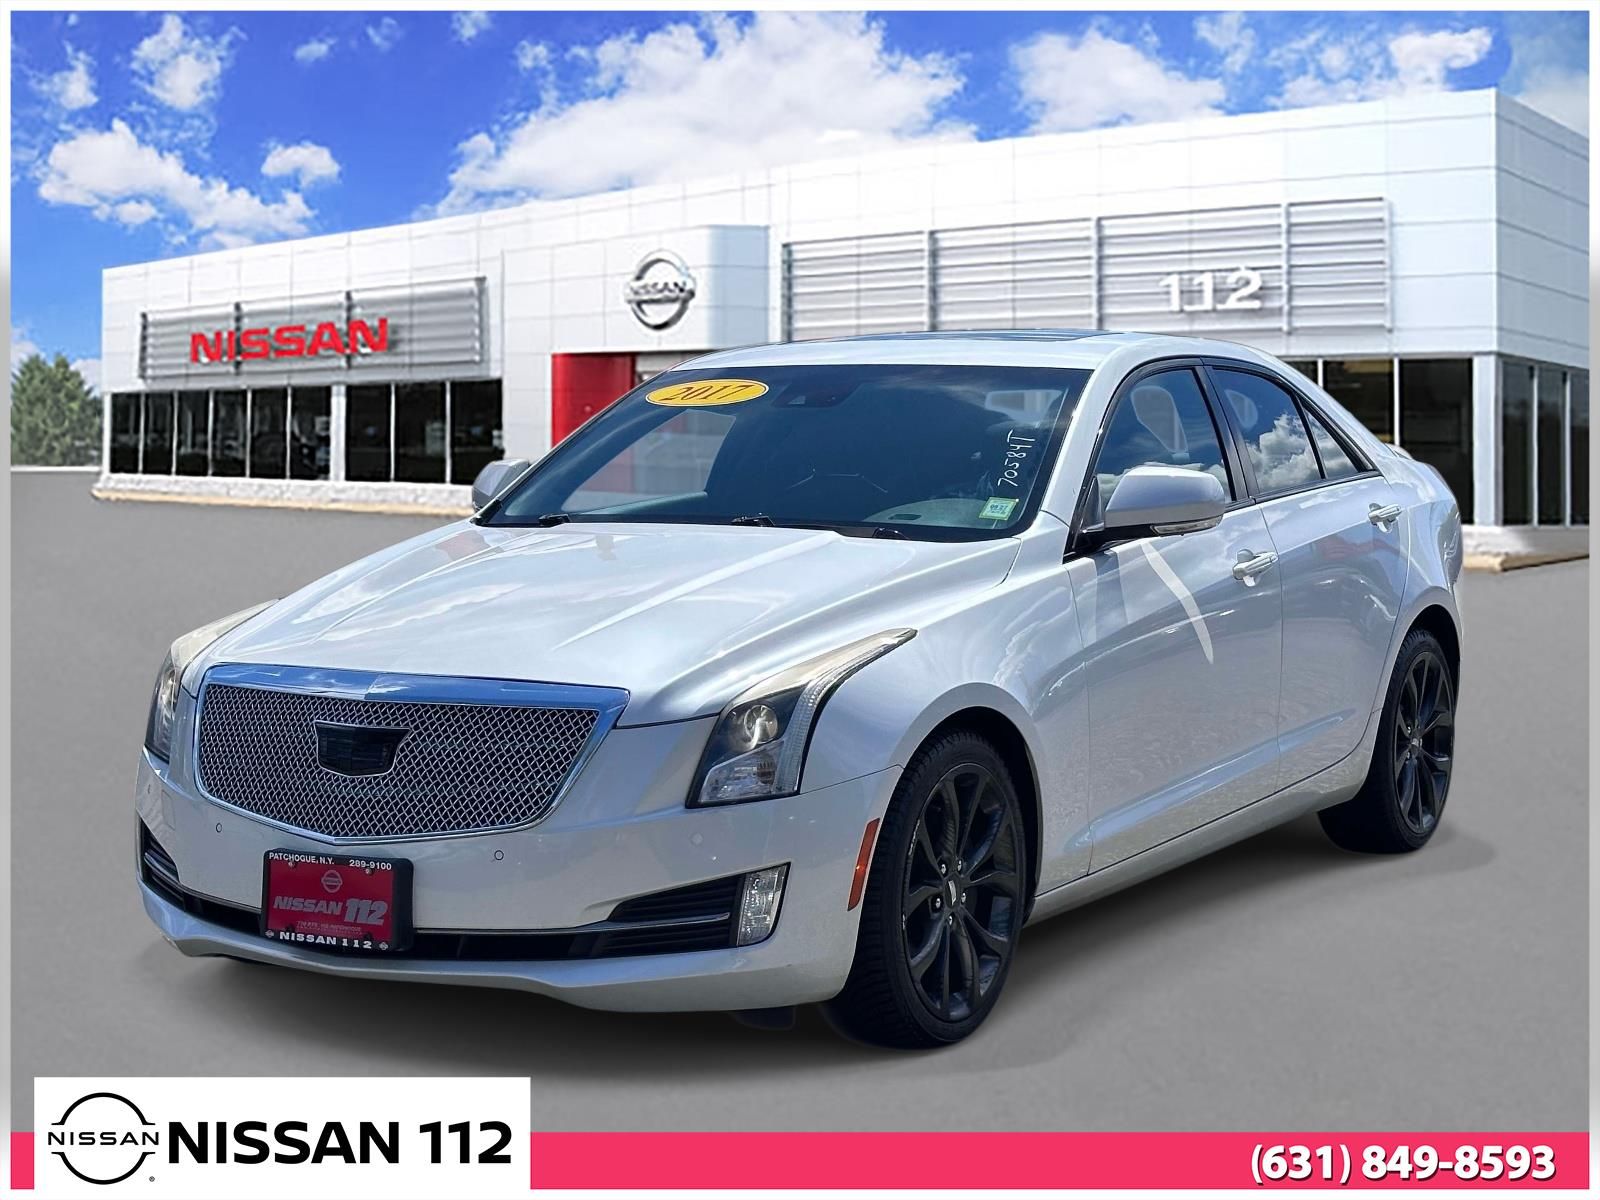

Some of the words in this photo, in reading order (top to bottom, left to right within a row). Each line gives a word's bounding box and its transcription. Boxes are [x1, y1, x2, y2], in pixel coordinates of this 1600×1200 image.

[1158, 268, 1262, 312] 112
[190, 317, 389, 364] NISSAN
[658, 385, 754, 401] 2017
[997, 429, 1036, 487] 70584T
[320, 855, 335, 865] N.Y.
[349, 859, 392, 871] 289-9100
[273, 895, 343, 915] NISSAN
[344, 898, 388, 926] 112
[279, 931, 337, 946] NISSAN
